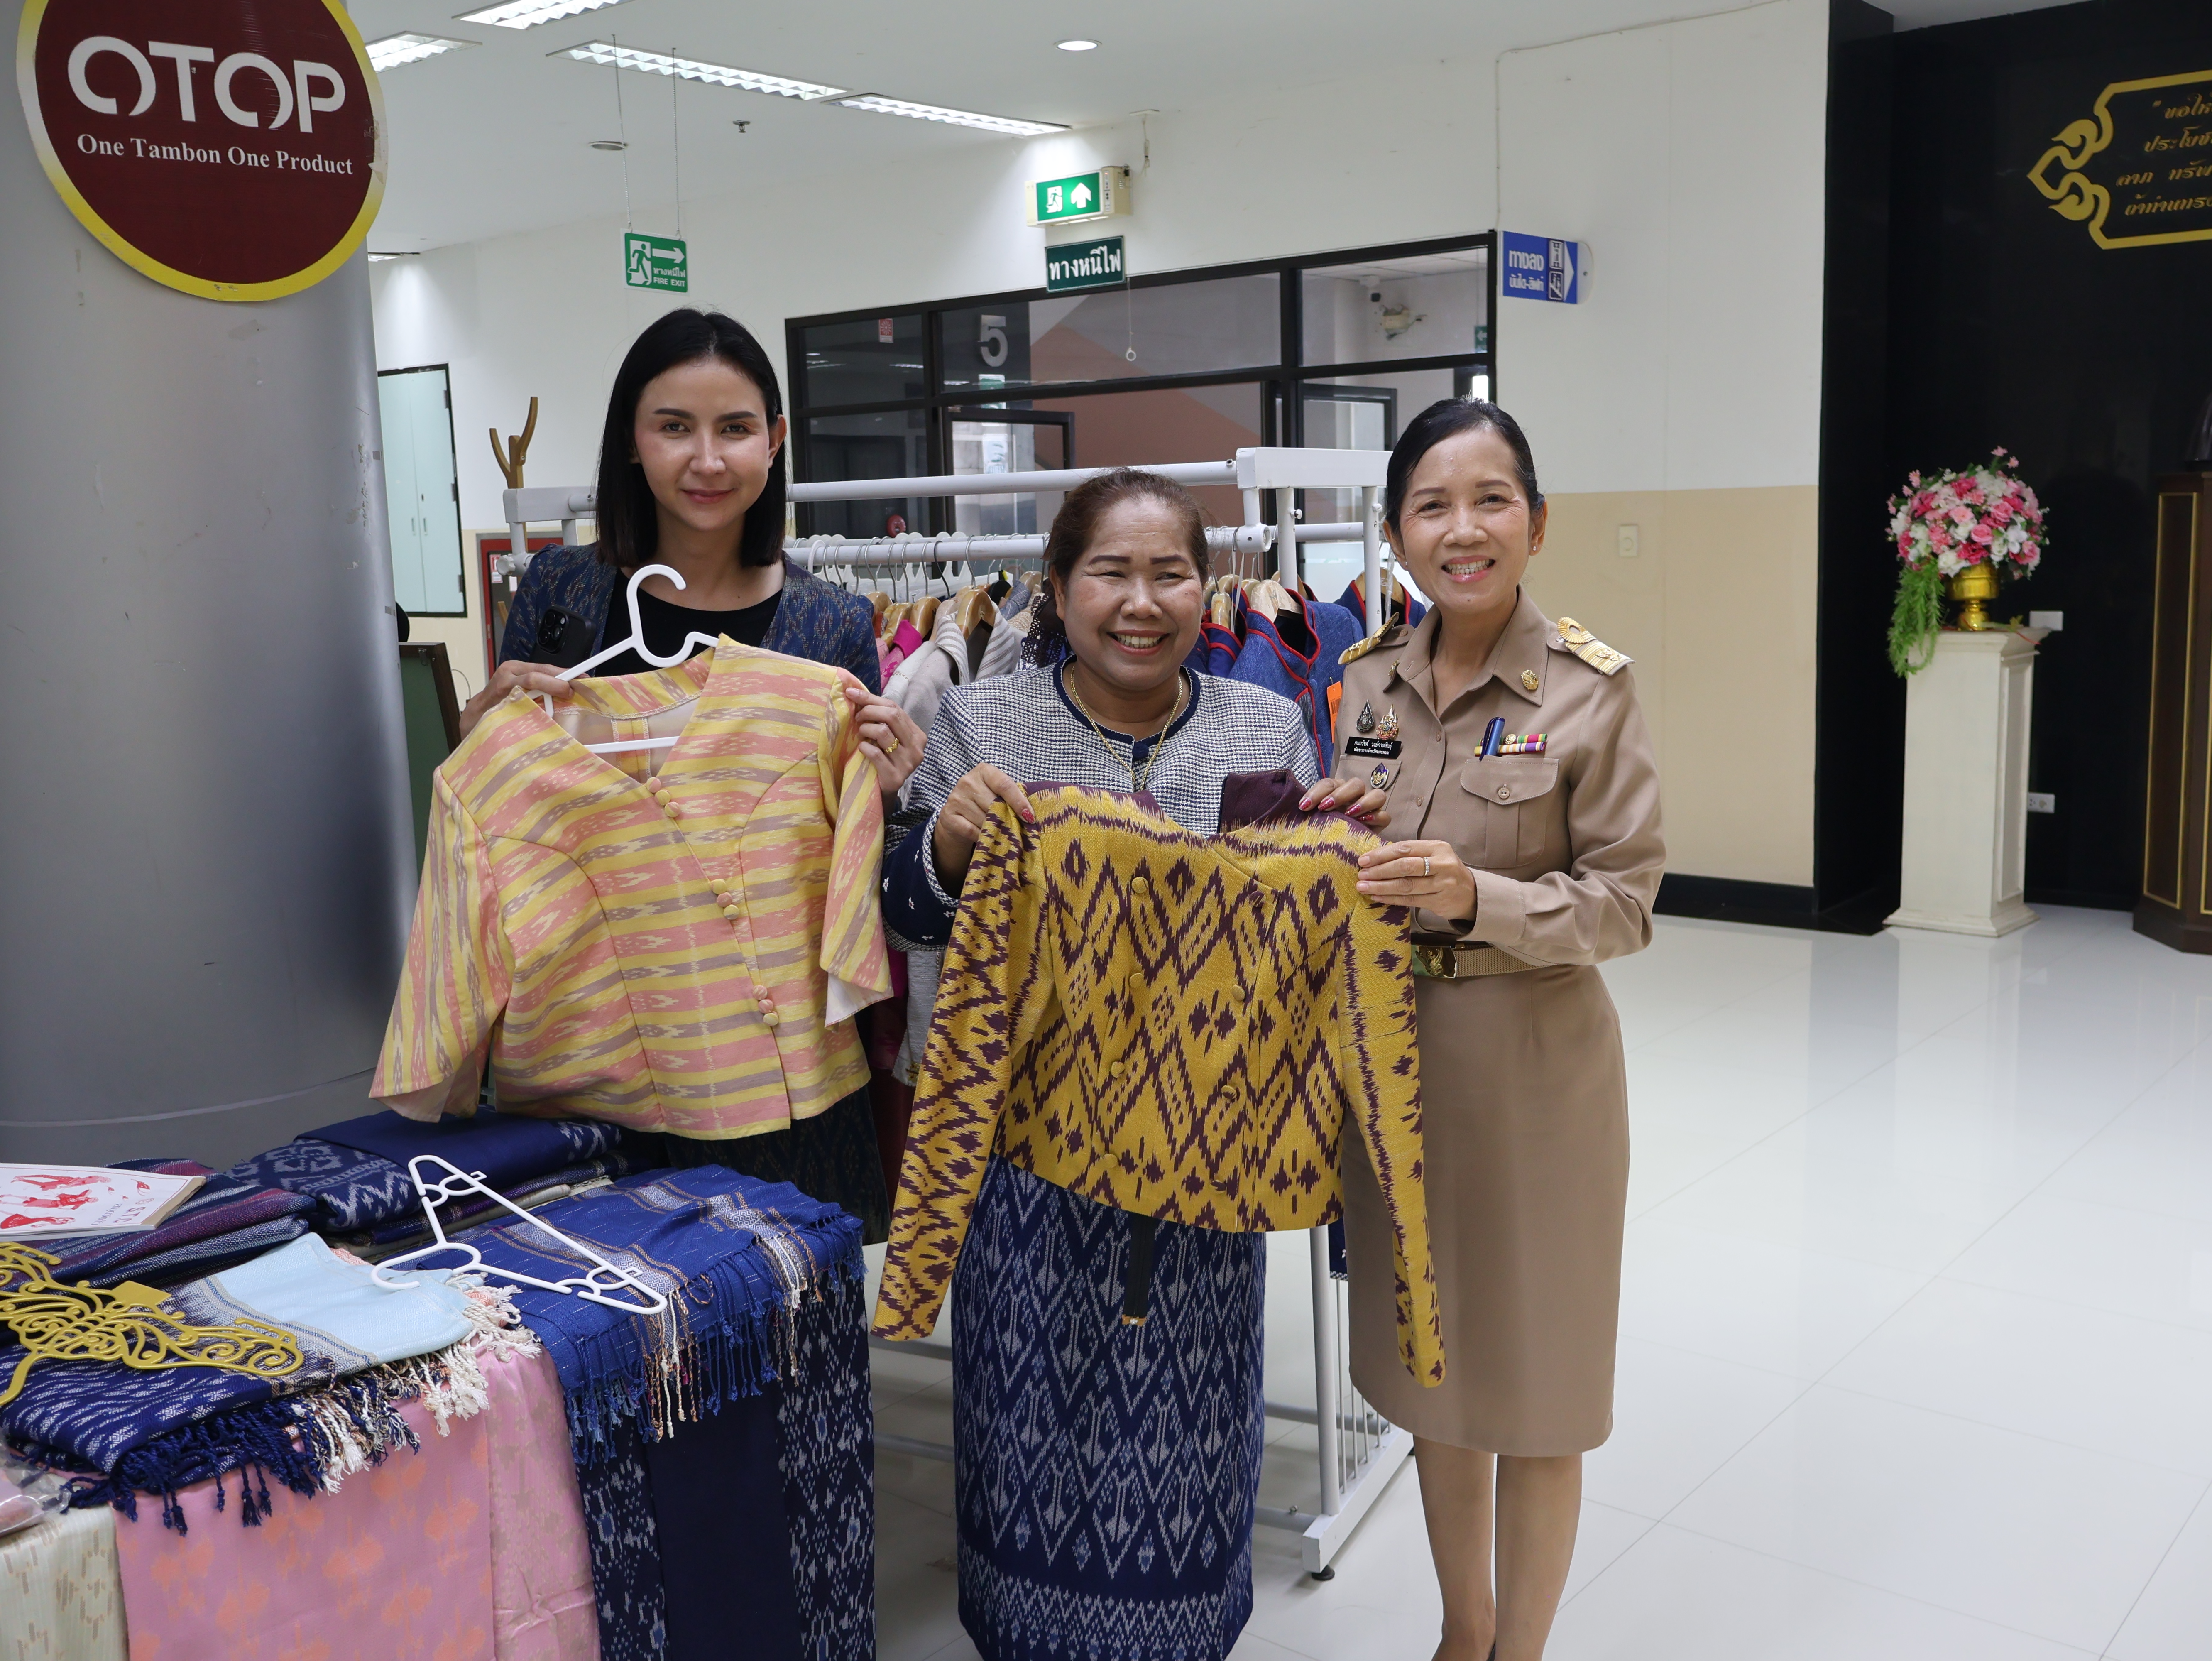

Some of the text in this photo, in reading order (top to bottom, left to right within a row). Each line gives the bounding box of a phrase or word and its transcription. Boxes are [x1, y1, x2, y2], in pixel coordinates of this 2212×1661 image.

[67, 35, 346, 133] OTOP
[77, 133, 353, 175] One Tambon One Product
[653, 267, 686, 277] ทางหนีไฟ
[1049, 245, 1121, 281] ทางหนีไฟ
[1509, 250, 1544, 271] ทางลง
[978, 314, 1008, 367] 5
